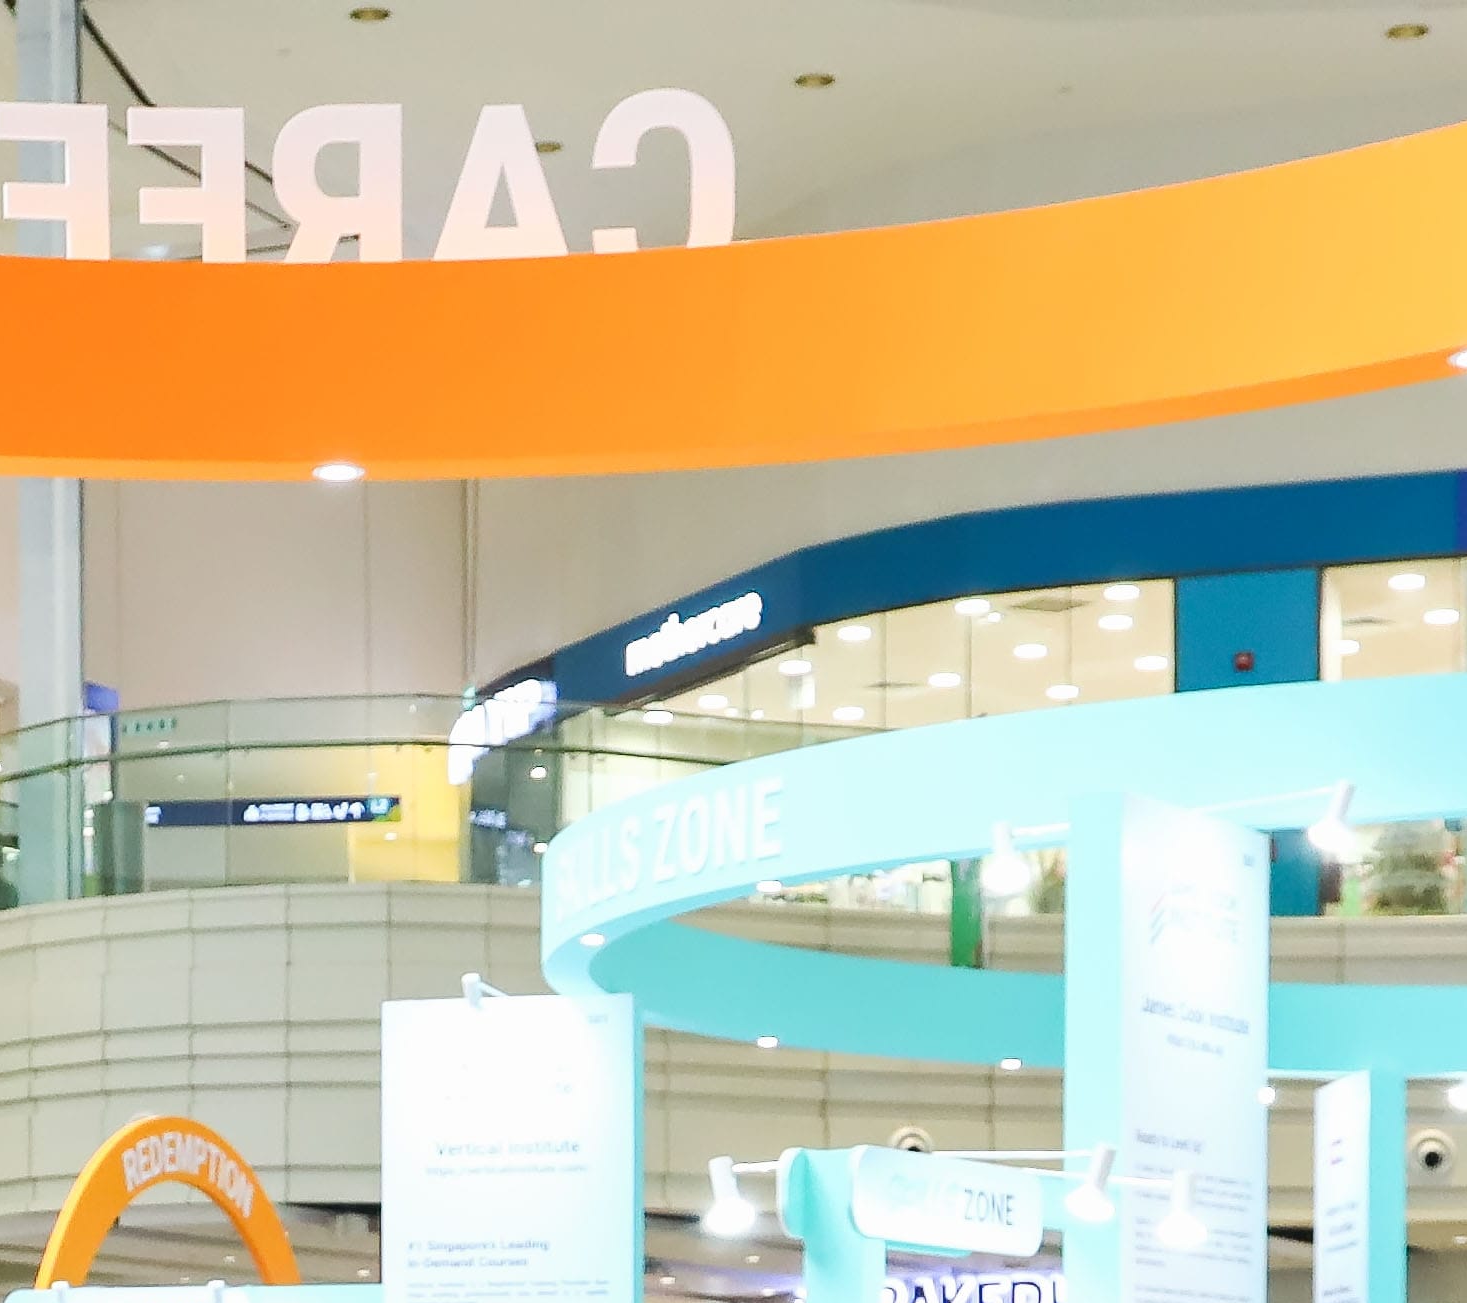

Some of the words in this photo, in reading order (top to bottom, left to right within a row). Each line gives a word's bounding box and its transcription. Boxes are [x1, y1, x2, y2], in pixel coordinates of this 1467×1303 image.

[652, 777, 783, 885] ZONE
[121, 1130, 256, 1220] REDEMPTION
[962, 1188, 1017, 1226] ZONE
